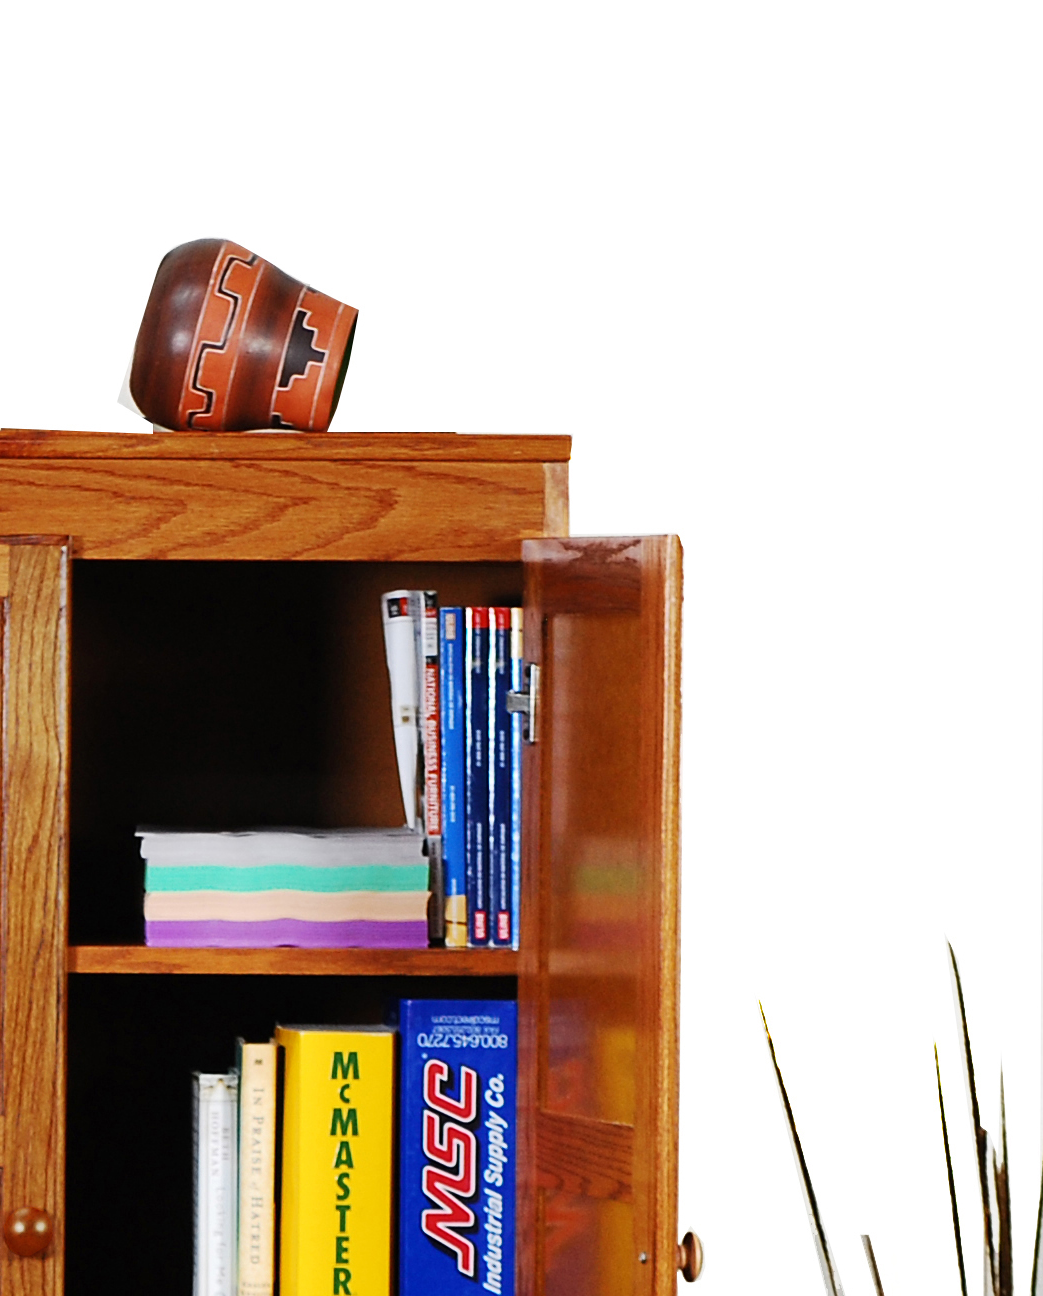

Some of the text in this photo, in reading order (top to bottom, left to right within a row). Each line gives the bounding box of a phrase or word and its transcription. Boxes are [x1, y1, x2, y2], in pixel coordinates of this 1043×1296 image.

[425, 668, 437, 716] NATIONAL
[426, 719, 438, 771] BUSINESS
[427, 773, 440, 832] FURNITURE
[417, 1033, 509, 1049] 800.645.7270
[421, 1058, 477, 1278] MSC
[482, 1073, 508, 1295] Industrial Supply Co.
